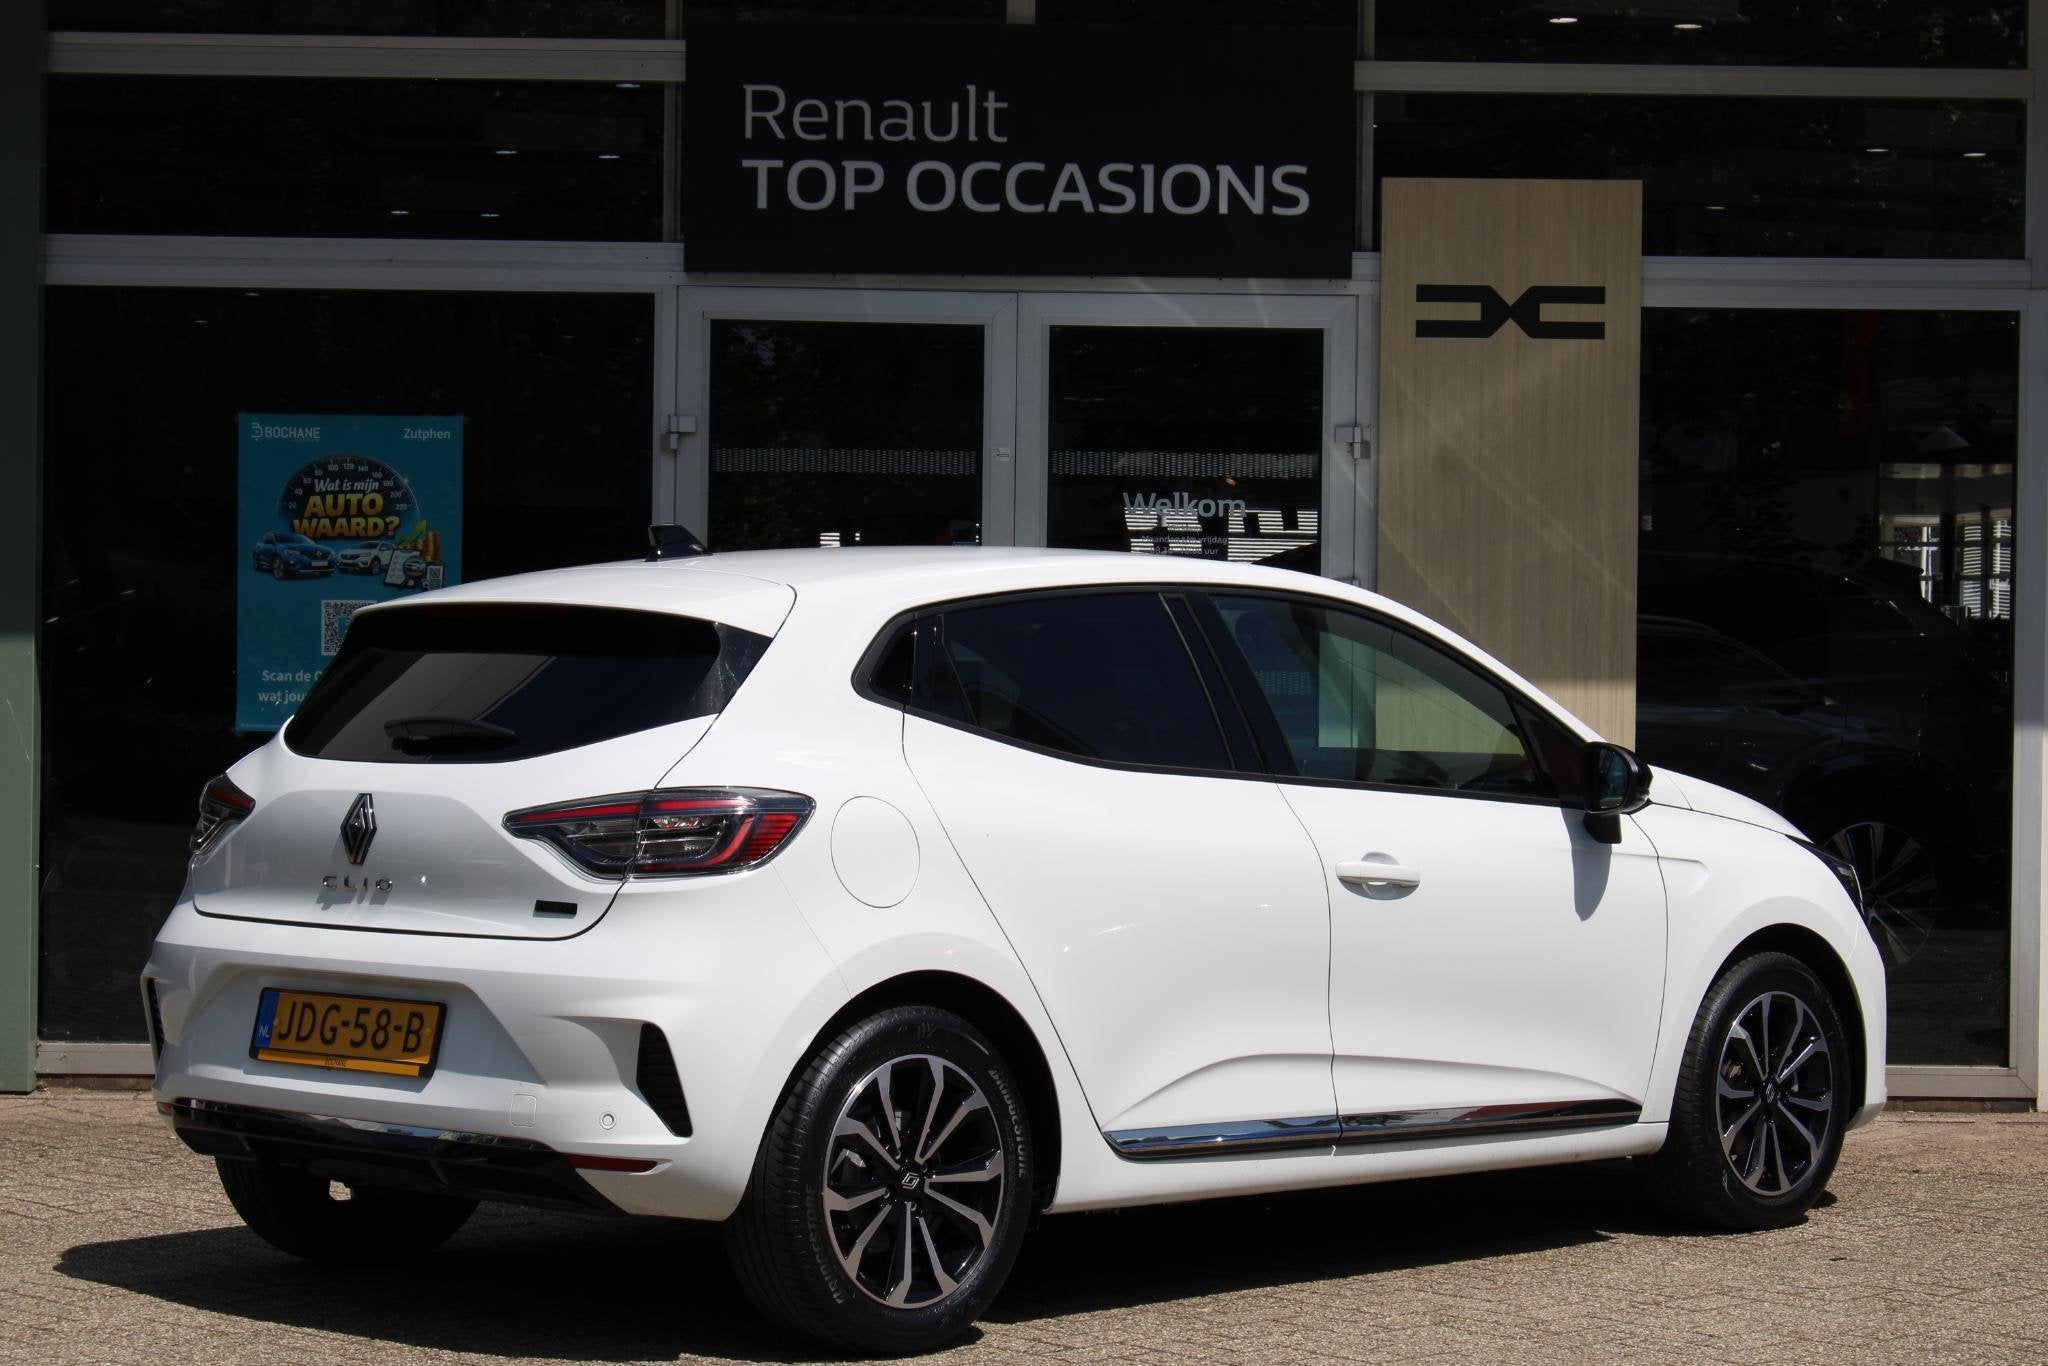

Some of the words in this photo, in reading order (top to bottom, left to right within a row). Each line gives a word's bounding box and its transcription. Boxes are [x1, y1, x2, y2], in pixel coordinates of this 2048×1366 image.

[742, 84, 1008, 142] Renault
[741, 159, 885, 210] TOP
[907, 160, 1310, 216] OCCASIONS
[264, 426, 321, 439] BOCHANE
[404, 428, 451, 441] Zutphen
[314, 478, 341, 493] Wat
[342, 479, 353, 491] is
[353, 478, 379, 493] mijn
[304, 492, 384, 518] AUTO
[1123, 492, 1247, 517] Welkom
[292, 515, 401, 538] WAARD?
[1200, 535, 1228, 545] vrijdag
[262, 670, 293, 682] Scan
[295, 670, 311, 682] de
[258, 690, 281, 702] wat
[283, 690, 307, 704] jou
[322, 874, 393, 894] CLIO
[258, 1025, 271, 1038] NL
[278, 1001, 425, 1053] JDG-58-B
